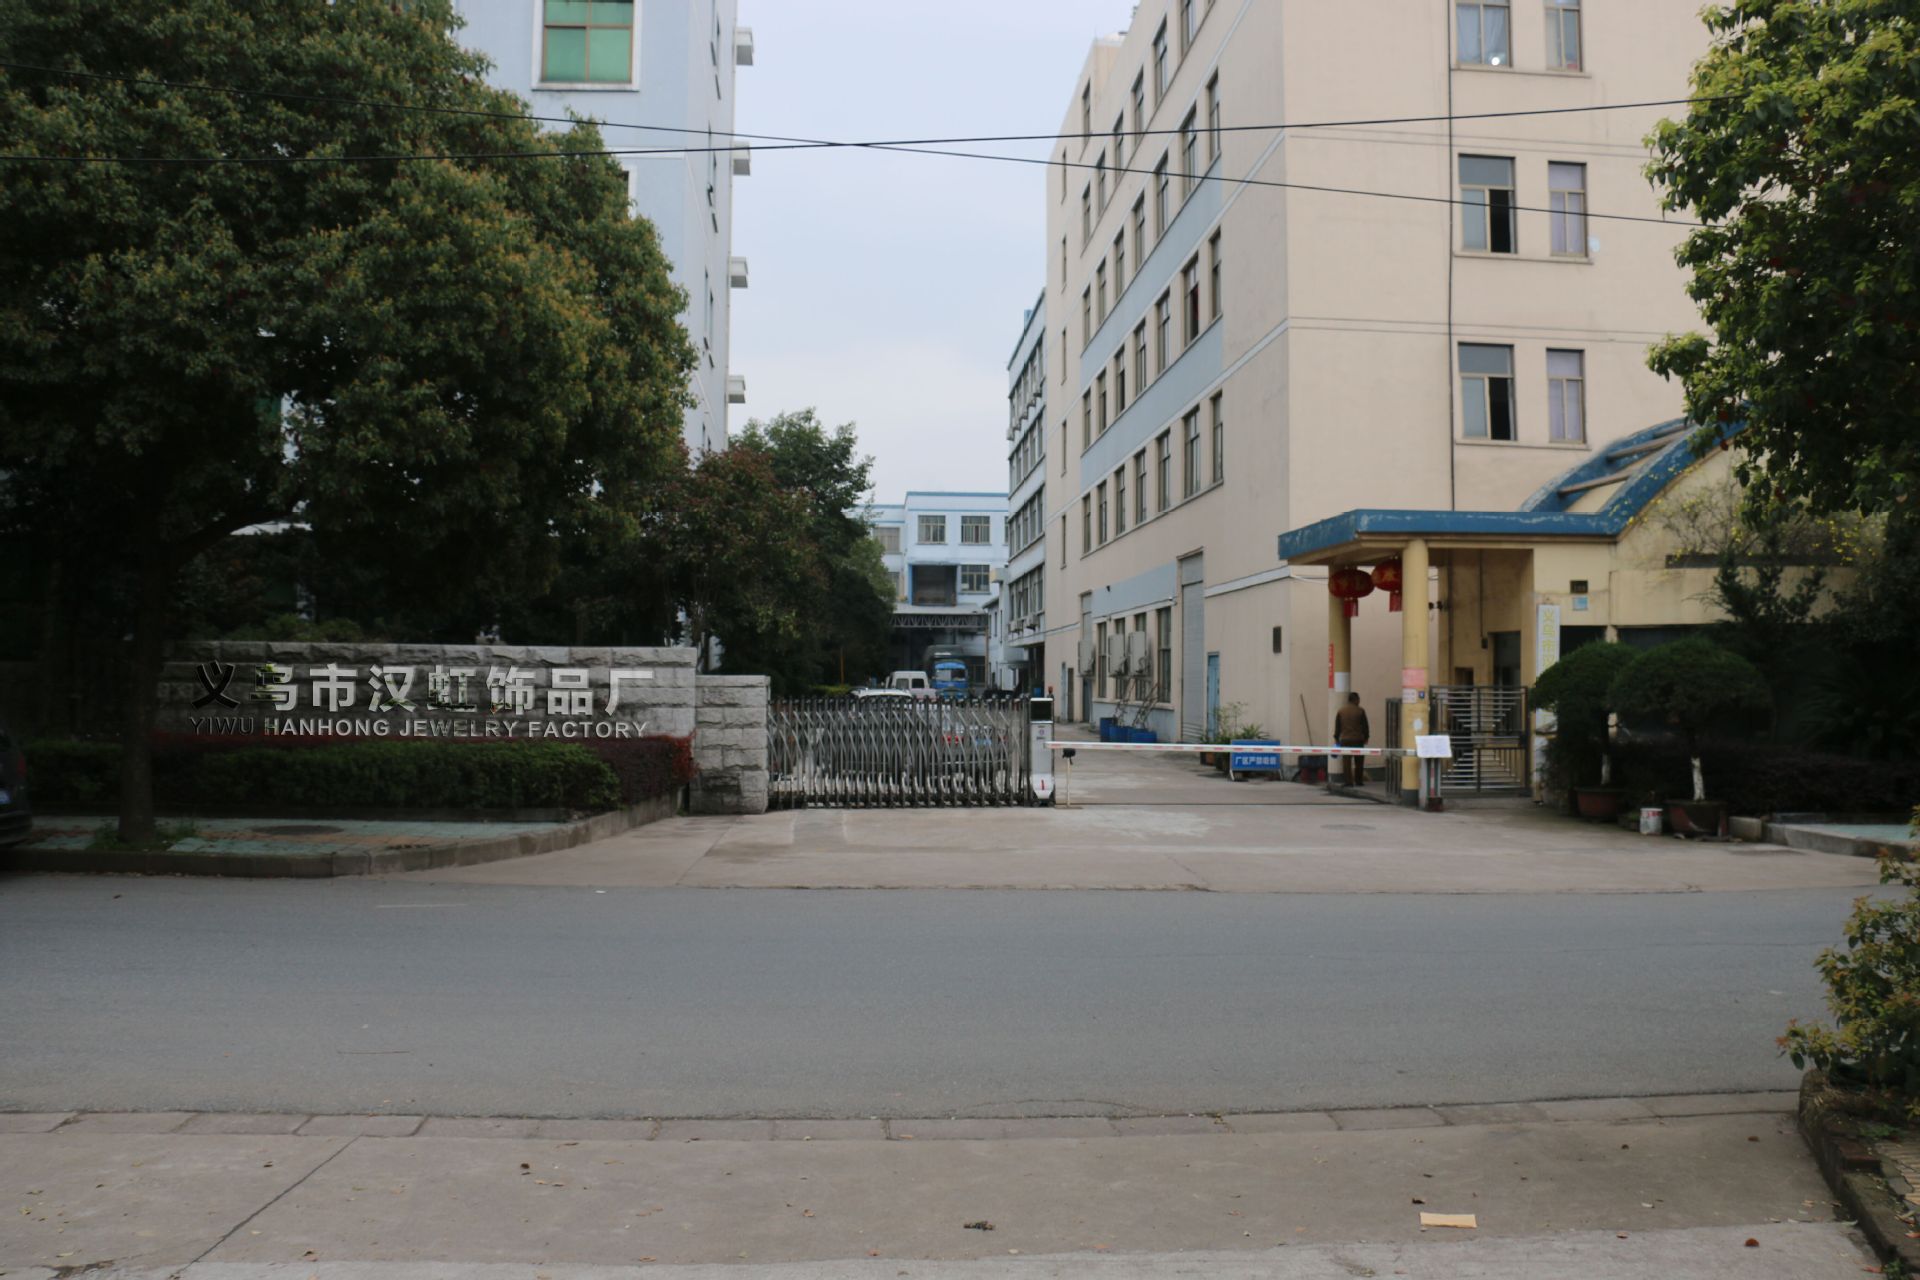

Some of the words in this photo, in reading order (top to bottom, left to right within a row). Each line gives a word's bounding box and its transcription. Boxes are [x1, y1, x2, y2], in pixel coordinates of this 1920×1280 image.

[190, 659, 653, 716] 义乌市汉虹饰品厂
[189, 716, 254, 736] YIWU
[264, 717, 390, 736] HANHONG
[399, 718, 519, 738] JEWELRY
[528, 719, 648, 739] FACTORY
